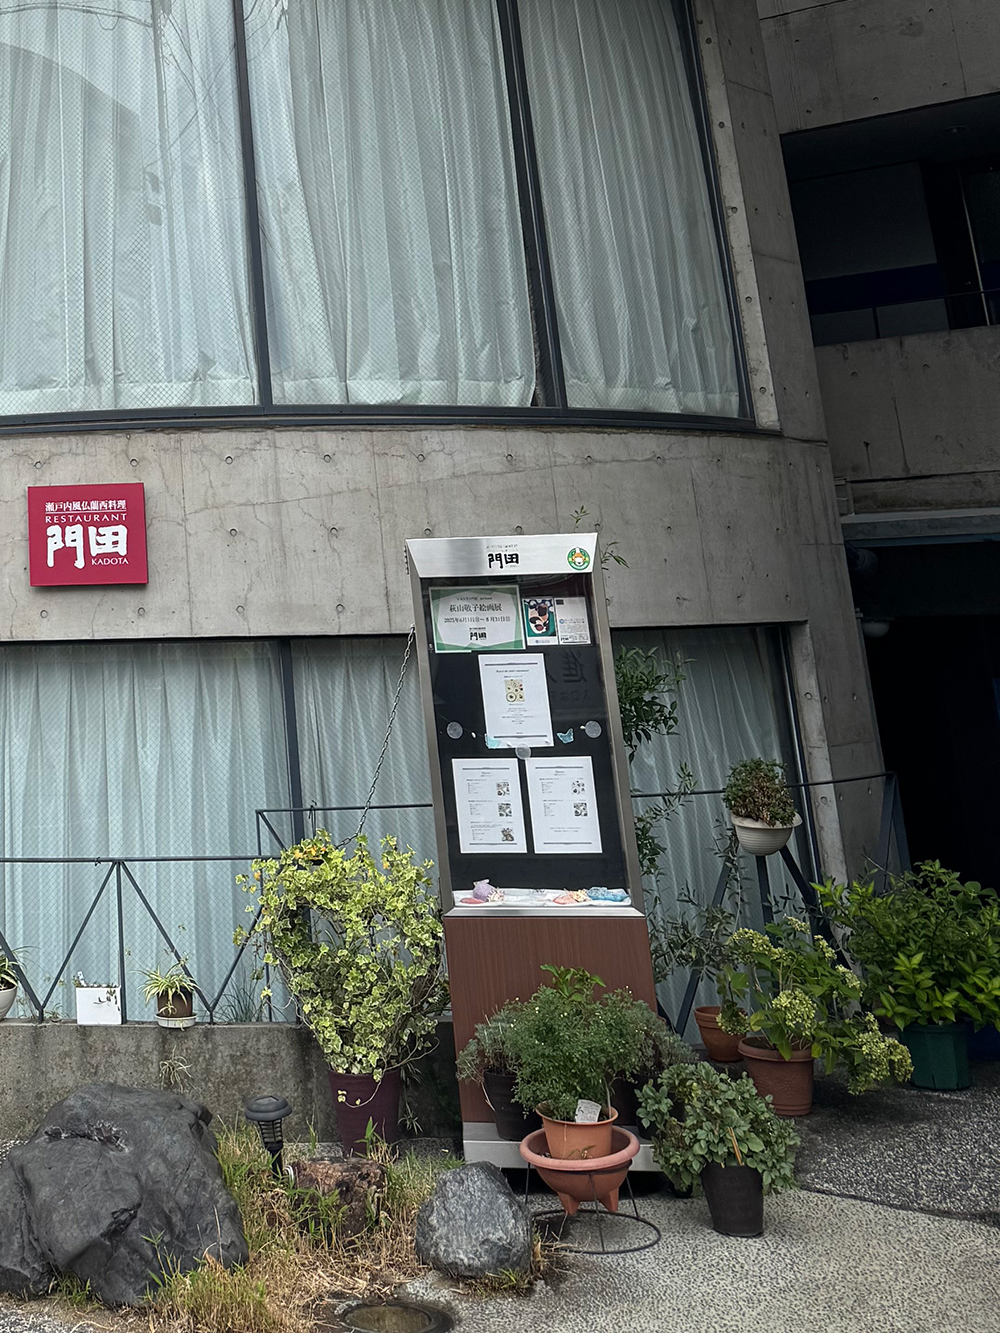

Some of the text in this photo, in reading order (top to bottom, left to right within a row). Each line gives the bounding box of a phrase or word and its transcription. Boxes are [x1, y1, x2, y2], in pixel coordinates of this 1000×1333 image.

[45, 499, 127, 512] 瀬戸内風仏蘭西料理
[45, 513, 127, 523] RESTAURANT
[46, 523, 128, 569] 門田
[91, 557, 129, 566] KADOTA
